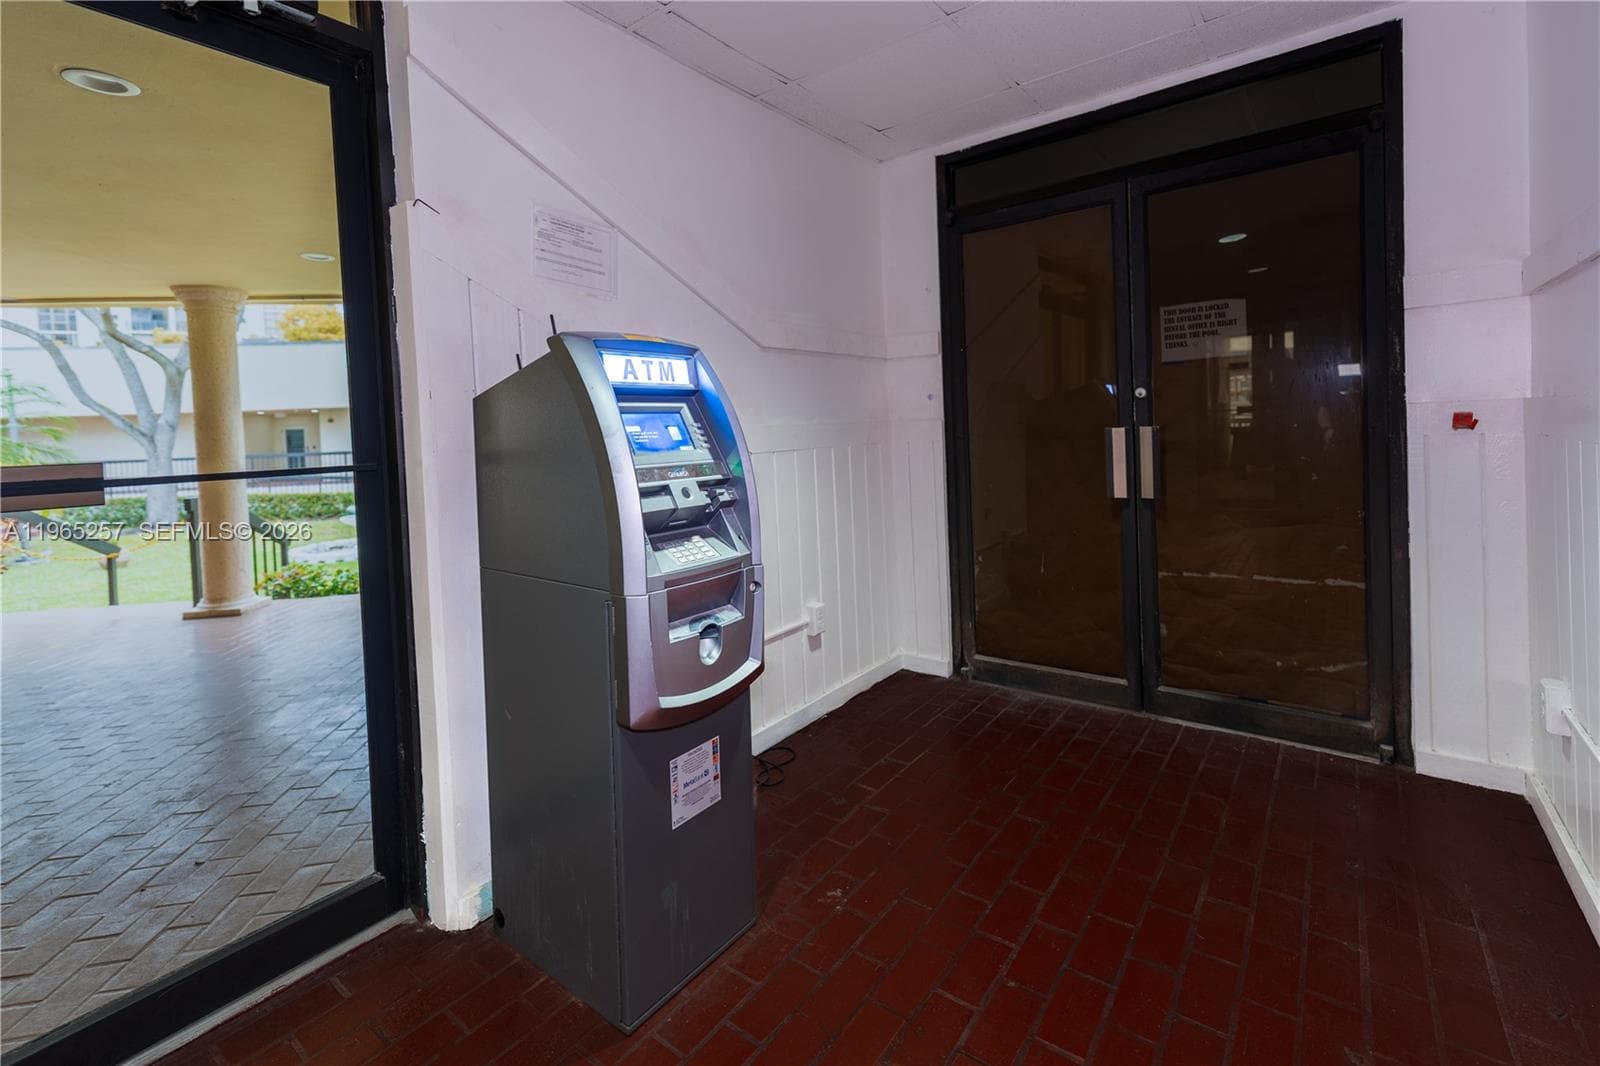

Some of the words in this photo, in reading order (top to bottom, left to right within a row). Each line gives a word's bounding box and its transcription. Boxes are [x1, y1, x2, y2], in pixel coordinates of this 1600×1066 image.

[1178, 306, 1196, 314] DOOR
[1214, 311, 1226, 319] THE
[1187, 322, 1207, 330] OFFICE
[1217, 318, 1237, 327] RIGHT
[1189, 330, 1200, 338] THE
[623, 358, 676, 382] ATM
